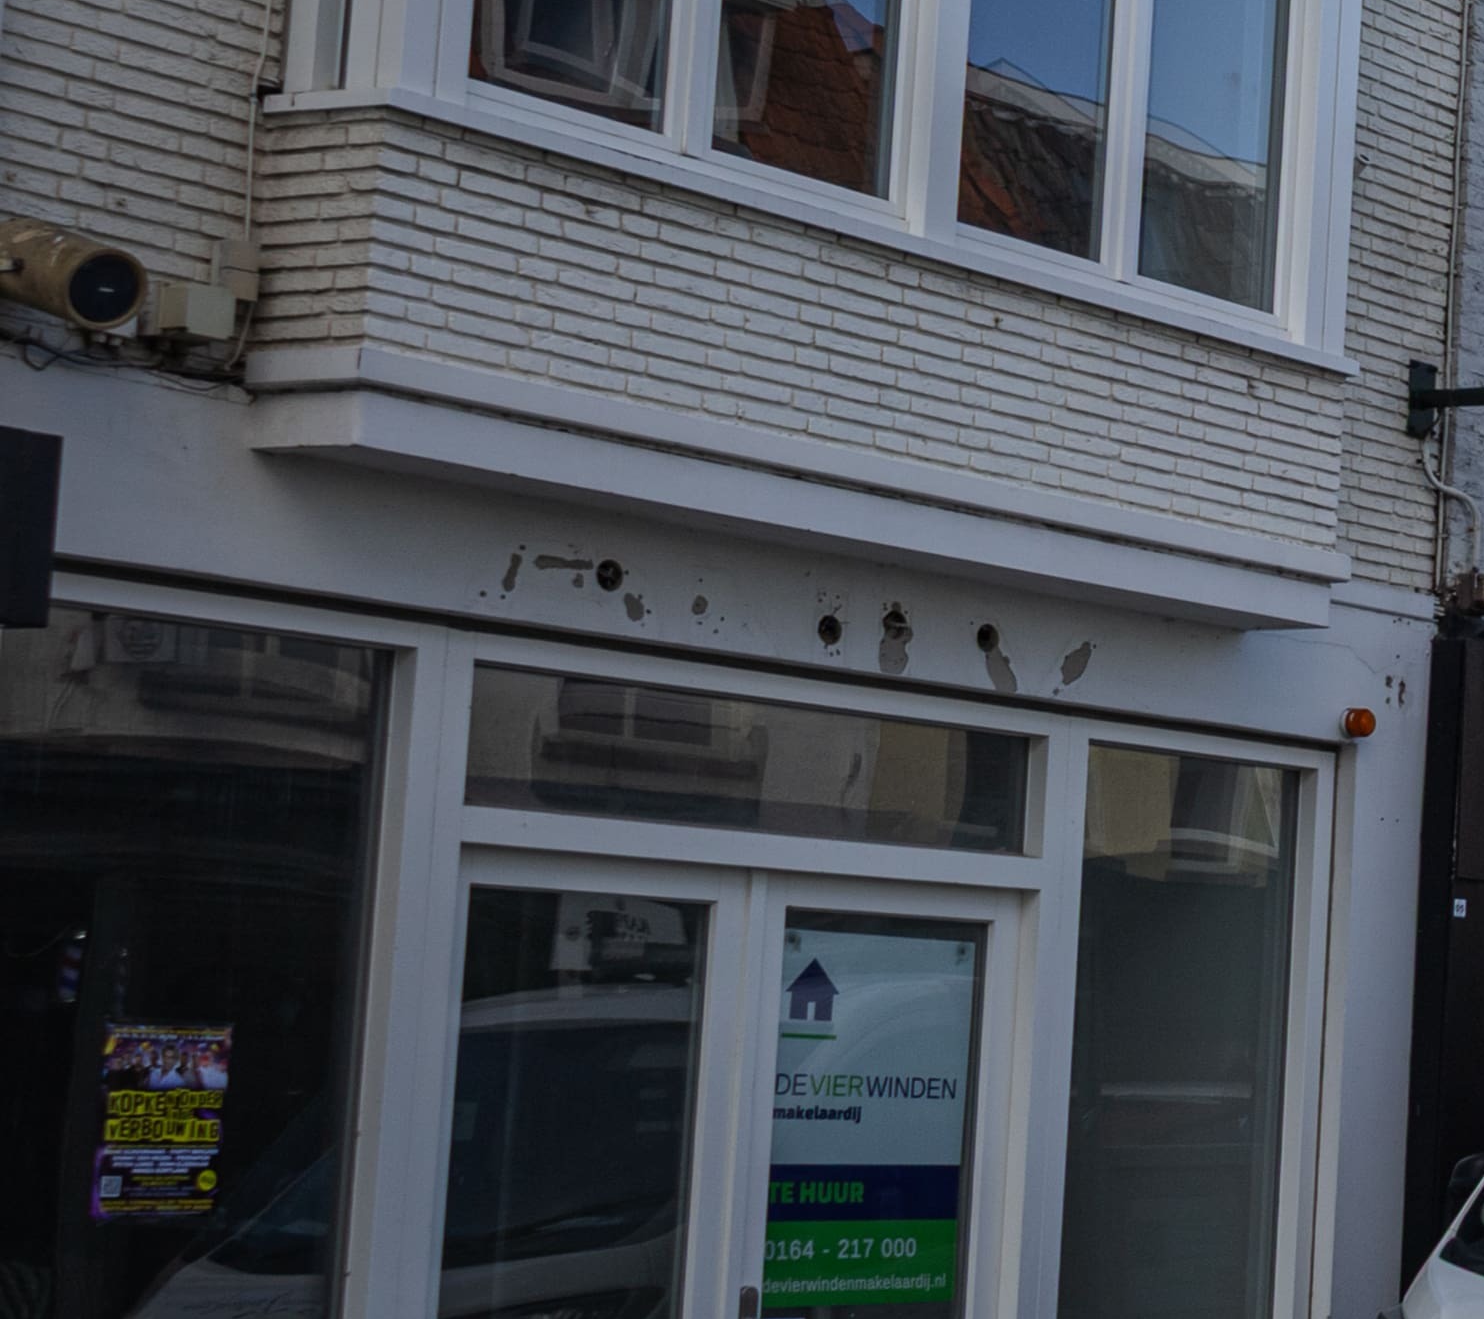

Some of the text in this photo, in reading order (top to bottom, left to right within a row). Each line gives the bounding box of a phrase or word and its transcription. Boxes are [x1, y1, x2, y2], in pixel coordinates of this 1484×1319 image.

[775, 1073, 957, 1100] DEVIERWINDEN
[773, 1106, 862, 1124] makelaardij
[770, 1181, 865, 1204] TE HUUR
[765, 1239, 815, 1260] 0164
[836, 1238, 874, 1260] 217
[880, 1237, 917, 1258] 000
